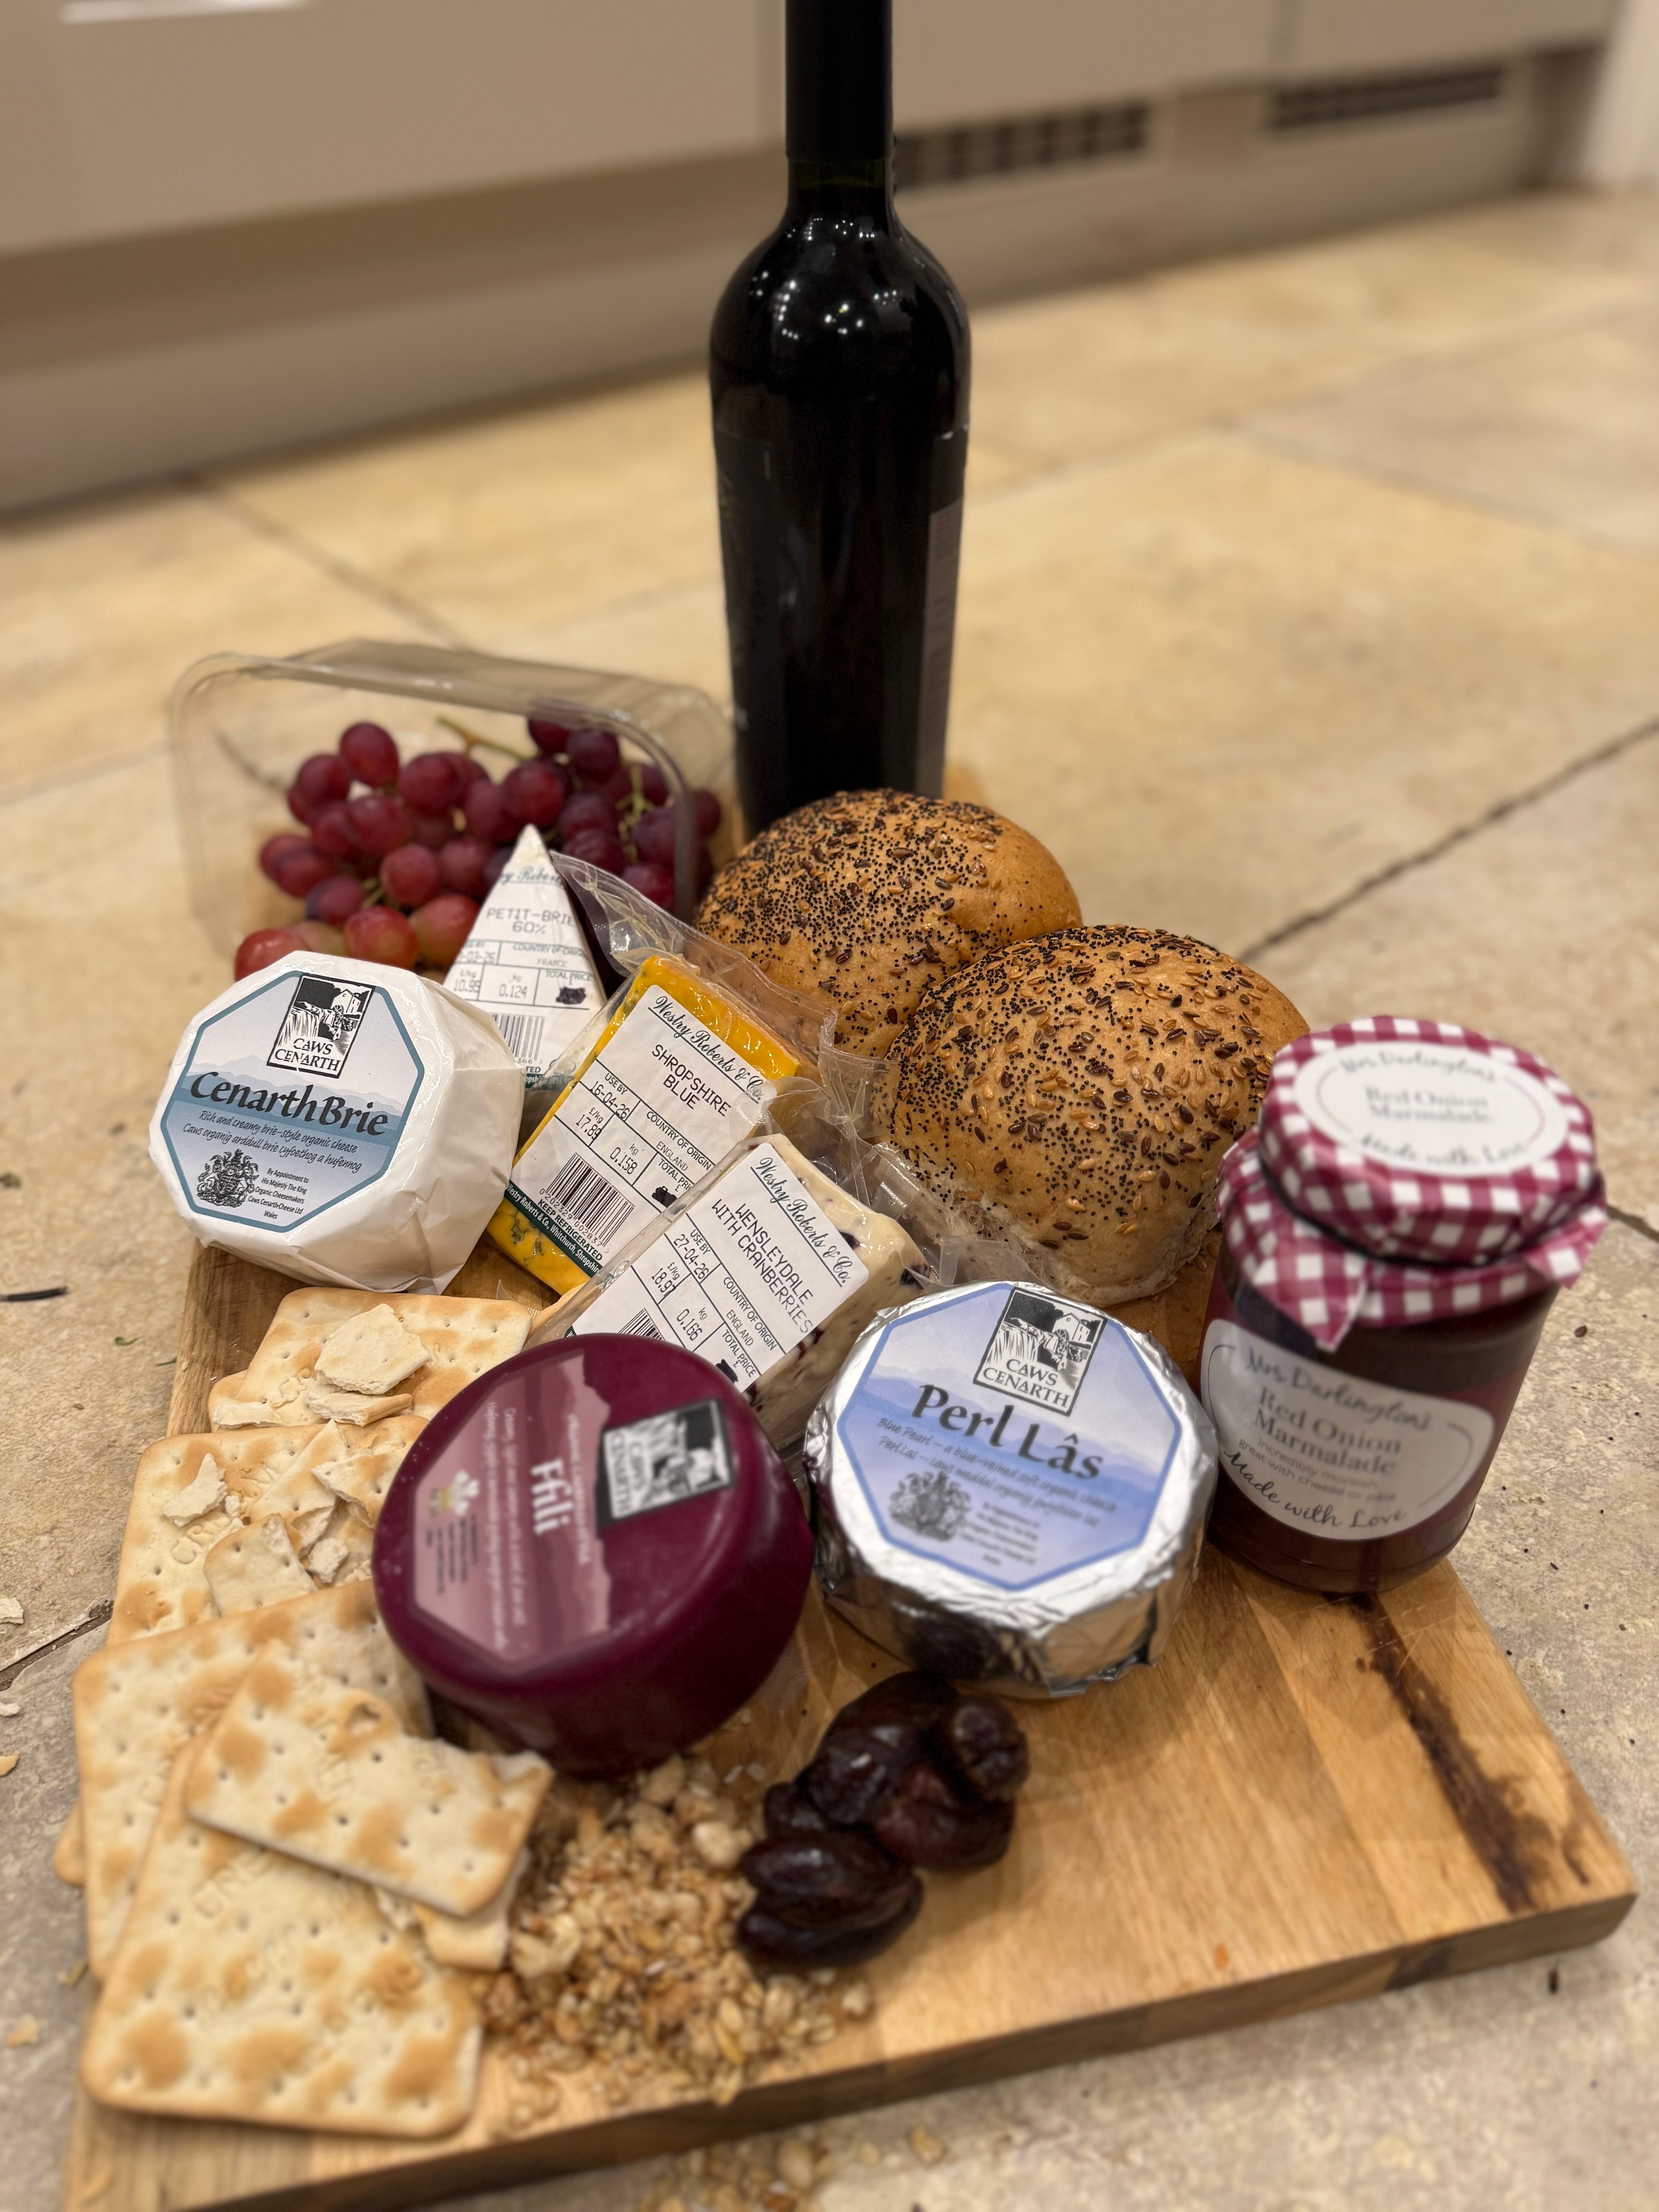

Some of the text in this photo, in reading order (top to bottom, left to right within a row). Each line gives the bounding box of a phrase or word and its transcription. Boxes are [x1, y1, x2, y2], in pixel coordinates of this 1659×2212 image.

[486, 908, 576, 928] PETIT-BRIE
[512, 921, 547, 934] 60%
[499, 984, 528, 999] 0.124
[545, 970, 592, 981] TOTAL PRICE
[293, 1038, 333, 1055] CAWS
[653, 996, 692, 1038] Westry
[691, 1030, 736, 1072] Roberts
[734, 1068, 750, 1081] &
[275, 1049, 341, 1071] CENARTH
[605, 1073, 628, 1095] USE BY
[652, 1044, 731, 1116] SHROPSHIRE
[663, 1074, 700, 1109] BLUE
[191, 1071, 388, 1136] Cenarth Brie
[588, 1107, 604, 1124] £/kg
[589, 1081, 630, 1119] 16-04-26
[199, 1110, 217, 1122] Rich
[216, 1116, 235, 1126] and
[232, 1119, 261, 1135] creamy
[301, 1135, 331, 1147] organic
[331, 1140, 358, 1154] cheese
[576, 1114, 602, 1141] 17.89
[646, 1111, 712, 1171] COUNTRY OF ORIGIN
[183, 1123, 204, 1135] Caws
[203, 1129, 233, 1145] organig
[232, 1136, 264, 1149] arddull
[262, 1140, 279, 1153] brie
[279, 1145, 318, 1164] cyfoethog
[324, 1154, 362, 1174] hufennog
[610, 1147, 638, 1175] 0.158
[629, 1143, 639, 1155] kg
[656, 1141, 689, 1171] ENGLAND
[267, 1167, 274, 1176] By
[273, 1170, 304, 1182] Appointment
[269, 1179, 288, 1190] Majesty
[288, 1183, 297, 1192] The
[296, 1185, 308, 1195] King
[658, 1158, 692, 1190] TOTAL PRI
[248, 1195, 261, 1204] Caws
[255, 1186, 305, 1204] Organic Cheesemakers
[520, 1197, 540, 1218] Roberts
[537, 1213, 544, 1222] &
[542, 1217, 550, 1230] Co.,
[549, 1224, 576, 1255] Whitchurch,
[575, 1249, 599, 1273] Shropshir
[537, 1198, 603, 1261] KEEP REFRIGERATED
[755, 1157, 853, 1284] Westry Roberts & Co.
[673, 1234, 709, 1280] 27-04-26
[690, 1229, 711, 1255] USE BY
[734, 1203, 814, 1305] WENSLEYDALE
[667, 1262, 680, 1281] £/kg
[711, 1198, 814, 1334] WITH CRANBERRIES
[676, 1308, 702, 1341] 0.166
[699, 1307, 708, 1321] kg
[723, 1277, 777, 1351] COUNTRY OF ORIGIN
[726, 1309, 754, 1347] ENGLAND
[722, 1329, 756, 1378] TOTAL PRICE
[983, 1367, 1071, 1408] CENARTH
[1006, 1358, 1058, 1386] CAWS
[877, 1417, 902, 1433] Blue
[902, 1426, 933, 1445] Pearl
[911, 1384, 1104, 1479] Perl Lâs
[1259, 1386, 1402, 1456] Red Onion
[878, 1435, 903, 1452] Perl
[1255, 1408, 1396, 1476] Marmalade
[1257, 1437, 1319, 1476] Incredibly
[1238, 1438, 1266, 1464] great
[1268, 1461, 1295, 1480] with
[1284, 1502, 1343, 1527] with
[1349, 1510, 1407, 1528] Love
